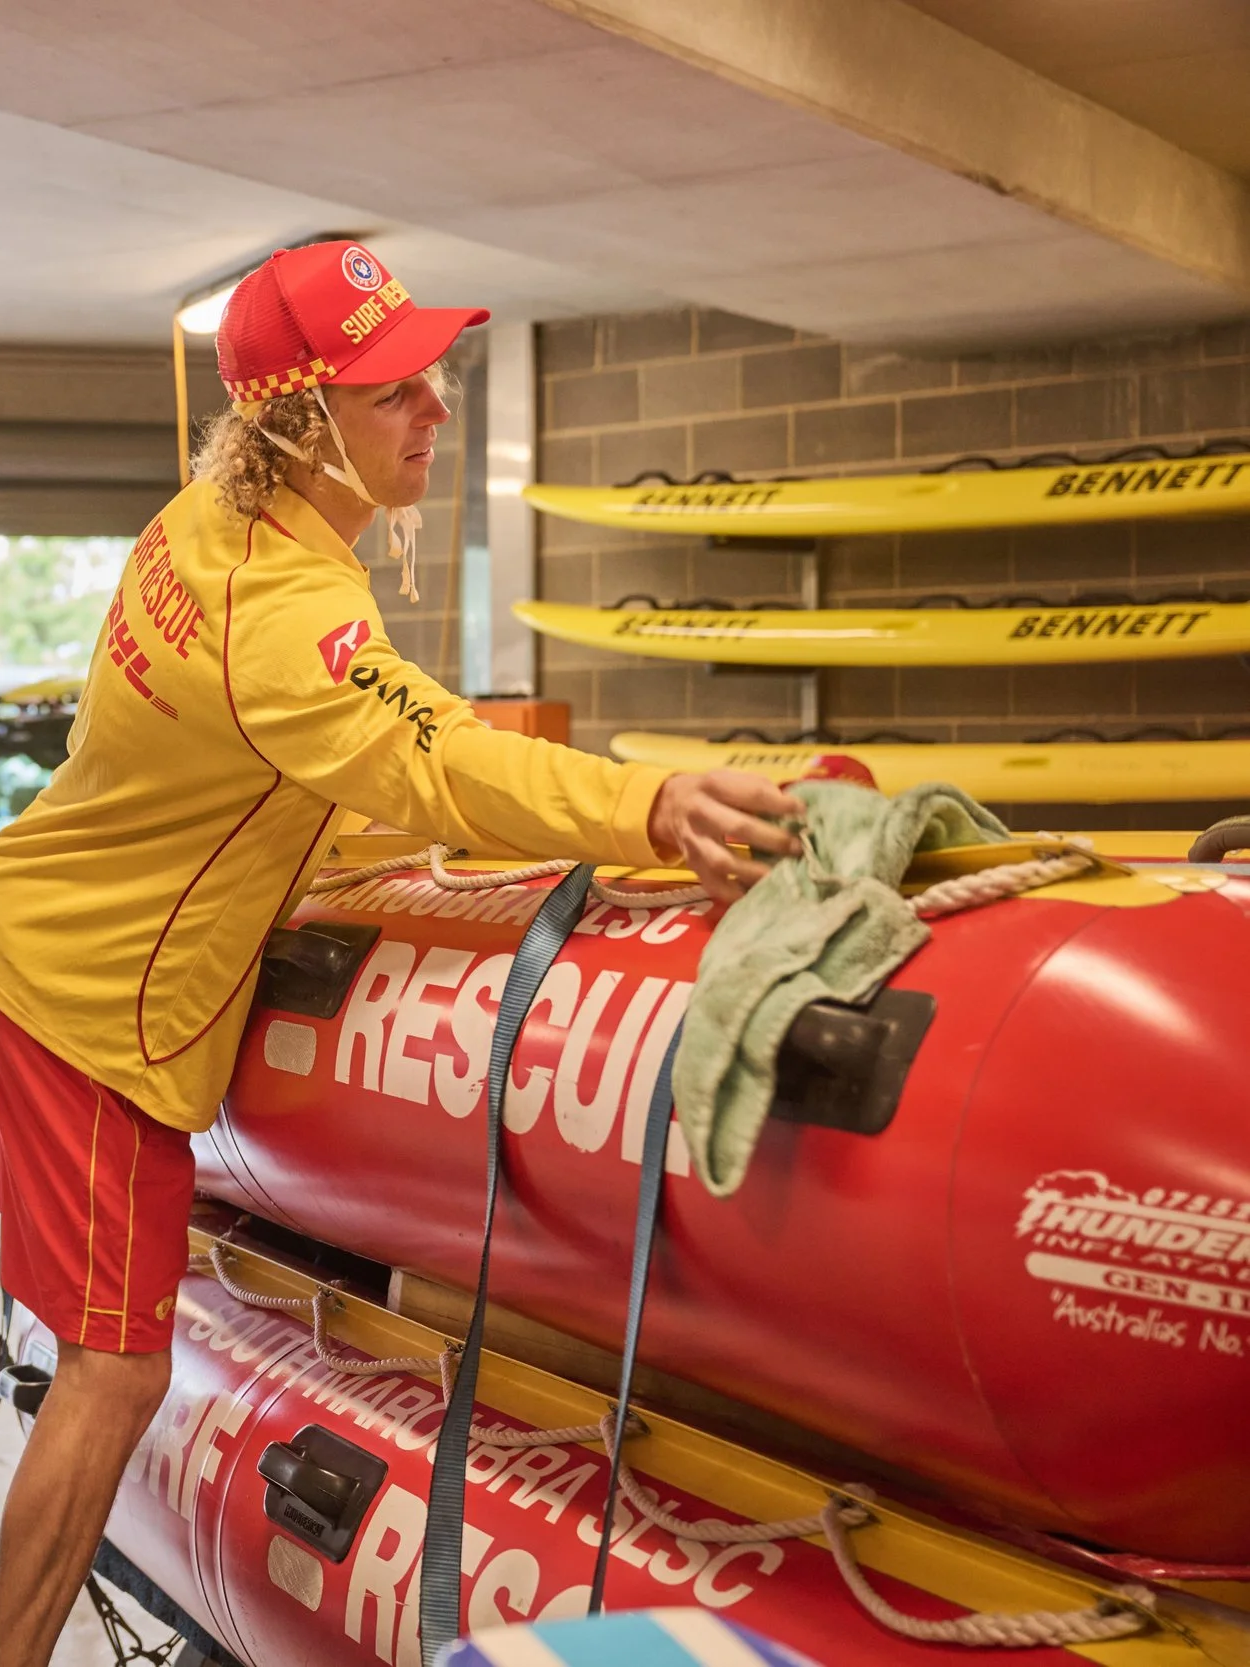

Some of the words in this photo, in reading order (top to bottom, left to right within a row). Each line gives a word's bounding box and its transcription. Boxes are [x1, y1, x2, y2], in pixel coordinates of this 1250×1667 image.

[340, 295, 387, 345] SURF
[1044, 463, 1244, 499] BENNETT
[134, 516, 169, 576] URF
[139, 550, 205, 661] RESCUE
[1008, 609, 1212, 641] BENNETT
[108, 587, 154, 700] DHL
[350, 666, 438, 753] QNAS
[572, 896, 715, 945] LSC
[188, 1303, 342, 1390] SOUTH
[302, 1366, 600, 1525] MAROBRA
[577, 1485, 784, 1609] SLSC
